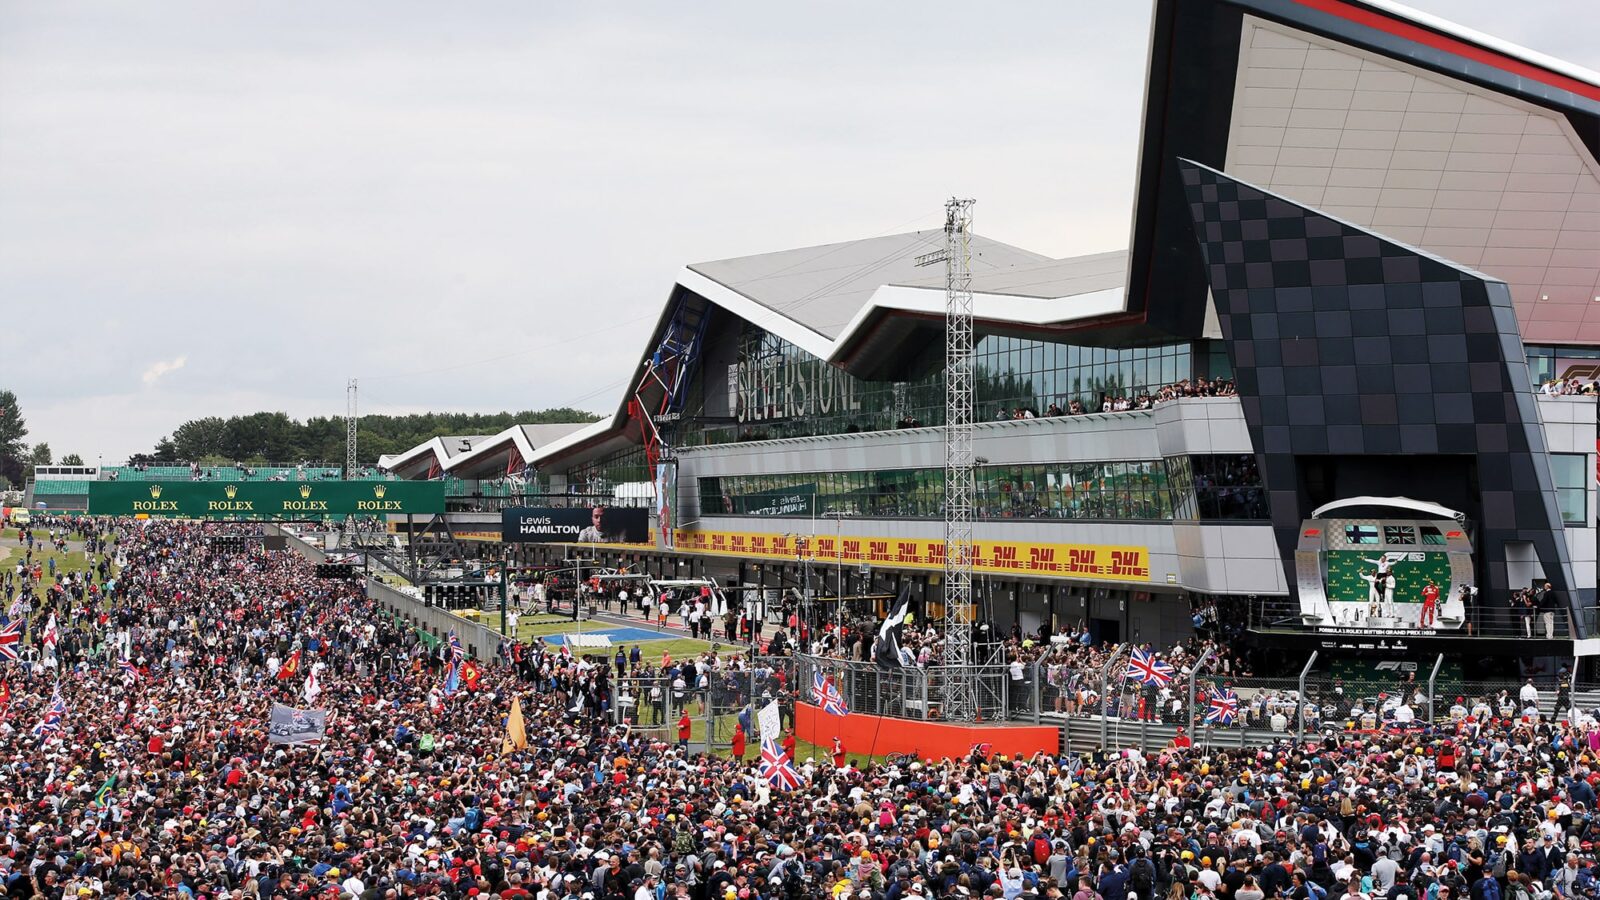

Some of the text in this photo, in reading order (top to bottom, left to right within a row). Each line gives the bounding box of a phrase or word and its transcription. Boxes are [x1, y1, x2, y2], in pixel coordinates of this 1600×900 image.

[133, 501, 402, 510] ROLEX ROLEX ROLEX ROLEX
[520, 516, 551, 525] Lewis
[520, 525, 580, 534] HAMILTON
[751, 537, 767, 553] DHL
[772, 538, 788, 555] DHL
[818, 539, 836, 558] DHL
[843, 541, 862, 559] DHL
[870, 542, 890, 561] DHL
[898, 543, 919, 563] DHL
[993, 546, 1019, 569] DHL
[1030, 548, 1058, 571] DHL
[1069, 549, 1098, 573] DHL
[1111, 551, 1142, 576] DHL
